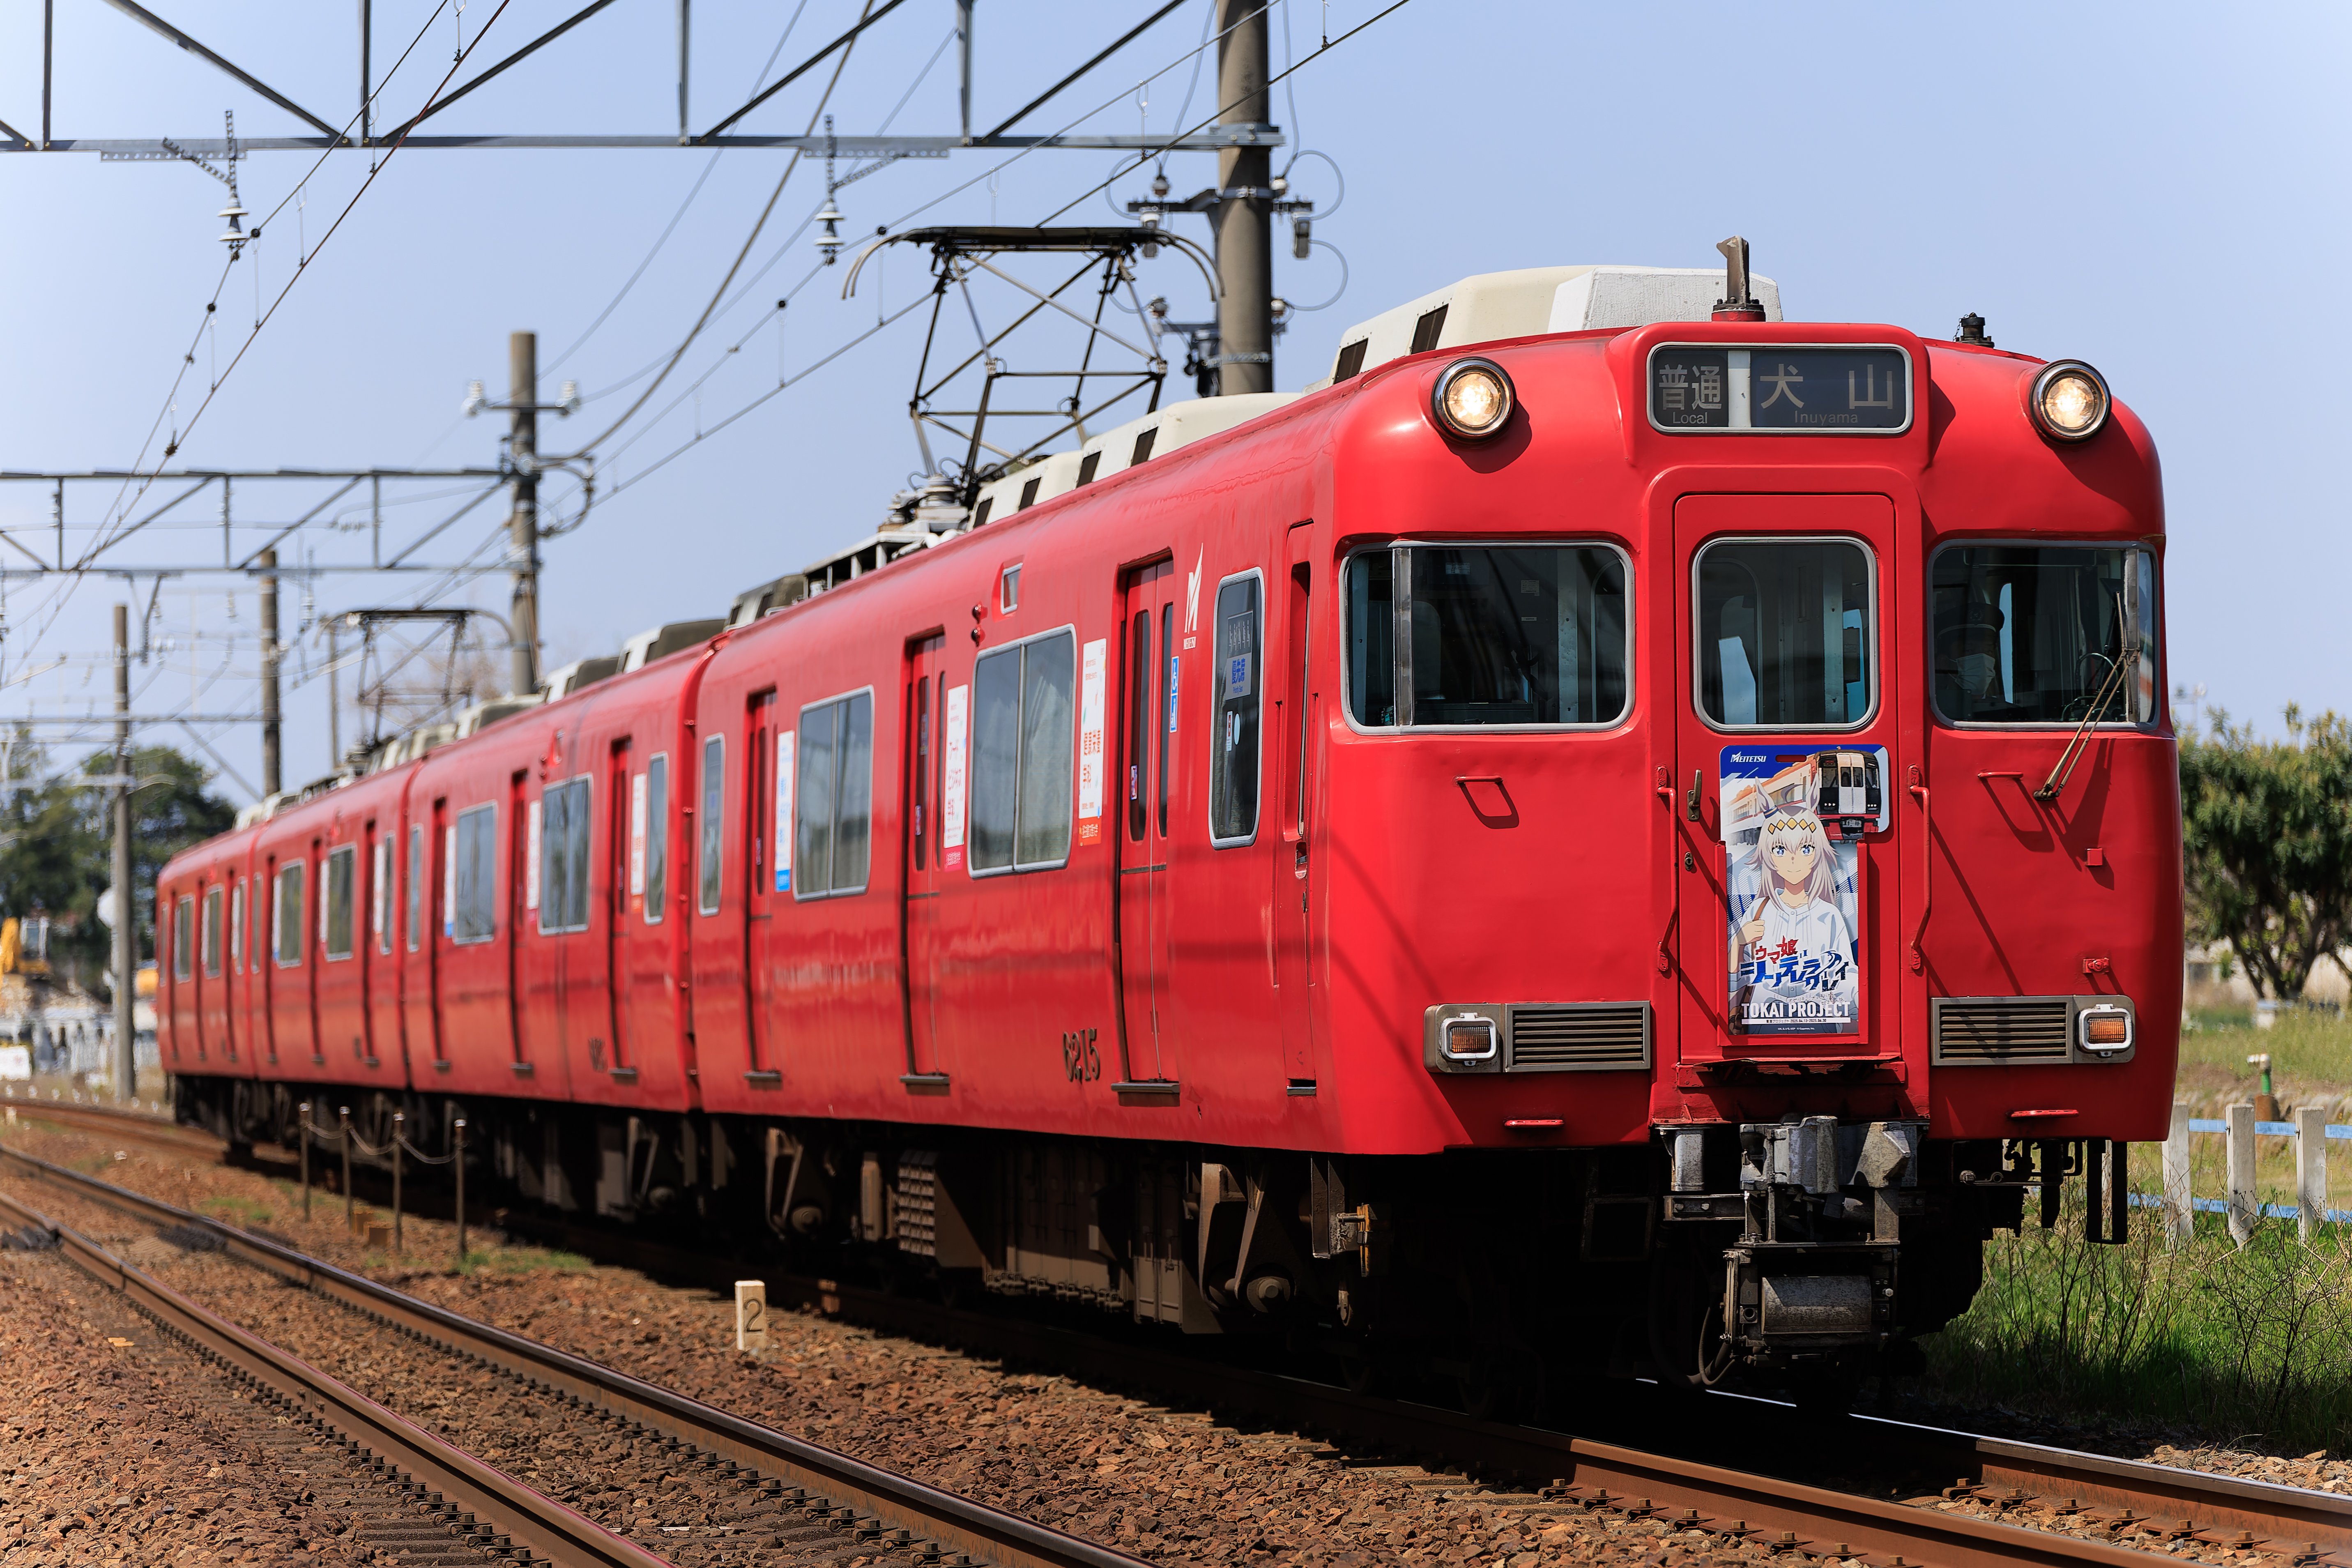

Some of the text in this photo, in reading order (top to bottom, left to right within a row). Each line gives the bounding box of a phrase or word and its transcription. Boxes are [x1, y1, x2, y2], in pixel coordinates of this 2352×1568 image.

[1659, 364, 1722, 410] 普通
[1760, 364, 1893, 410] 犬山
[1672, 412, 1708, 425] Local
[1794, 412, 1858, 426] Inuyama
[1730, 751, 1767, 762] MEITETSU
[1755, 935, 1800, 964] ウマ娘
[1740, 949, 1849, 992] シンデレラグレイ
[1741, 1003, 1784, 1018] TOKAI
[1788, 1002, 1850, 1017] PROJECT
[1063, 1027, 1100, 1083] 6215
[743, 1298, 762, 1332] 2
